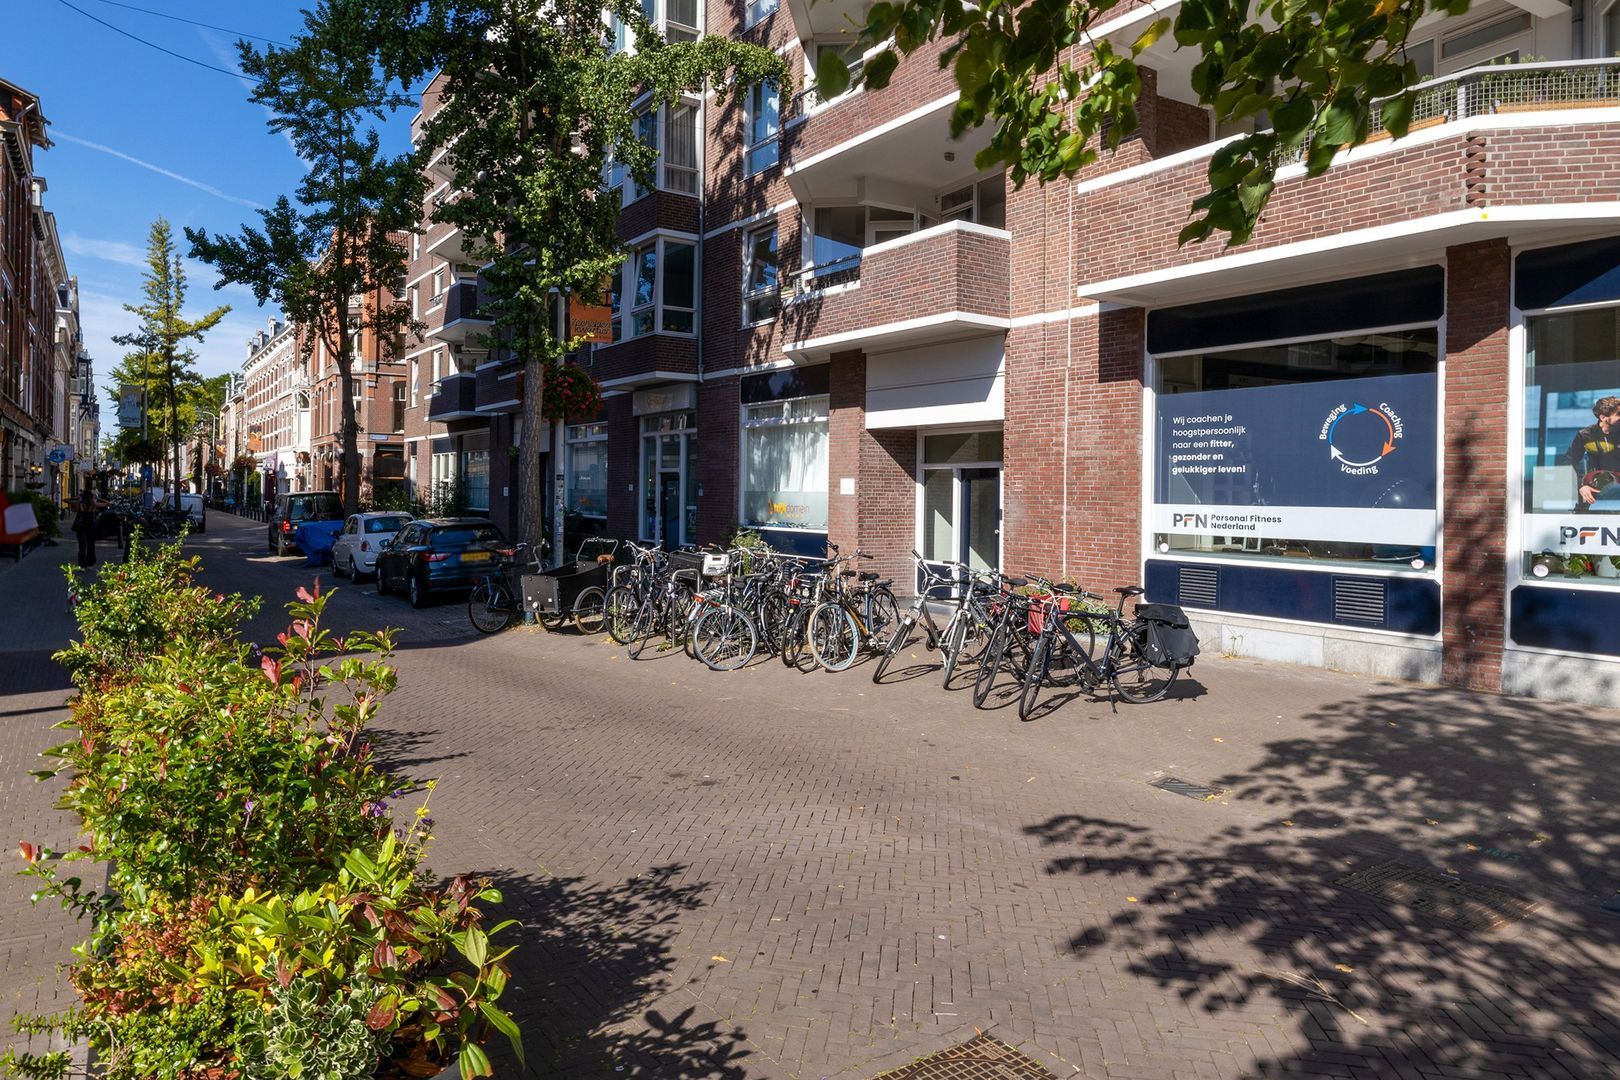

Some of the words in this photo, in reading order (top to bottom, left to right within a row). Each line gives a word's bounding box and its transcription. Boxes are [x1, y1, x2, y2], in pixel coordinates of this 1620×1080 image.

[1173, 417, 1185, 425] Wij
[1186, 415, 1223, 423] coachen
[1224, 414, 1232, 423] je
[1319, 403, 1347, 440] Beweging
[1379, 402, 1403, 439] Coaching
[1172, 426, 1246, 437] hoogstpersoonlijk
[1193, 441, 1209, 449] een
[1210, 439, 1235, 449] fitter,
[1172, 453, 1211, 463] gezonder
[1212, 453, 1224, 461] en
[1172, 465, 1217, 476] gelukkiger
[1218, 464, 1246, 473] leven!
[1341, 464, 1378, 475] Voeding
[1173, 513, 1208, 528] PFN
[1210, 514, 1248, 522] Personal
[1249, 514, 1282, 524] Fitness
[1210, 522, 1256, 531] Nederland
[1560, 525, 1620, 546] PFN
